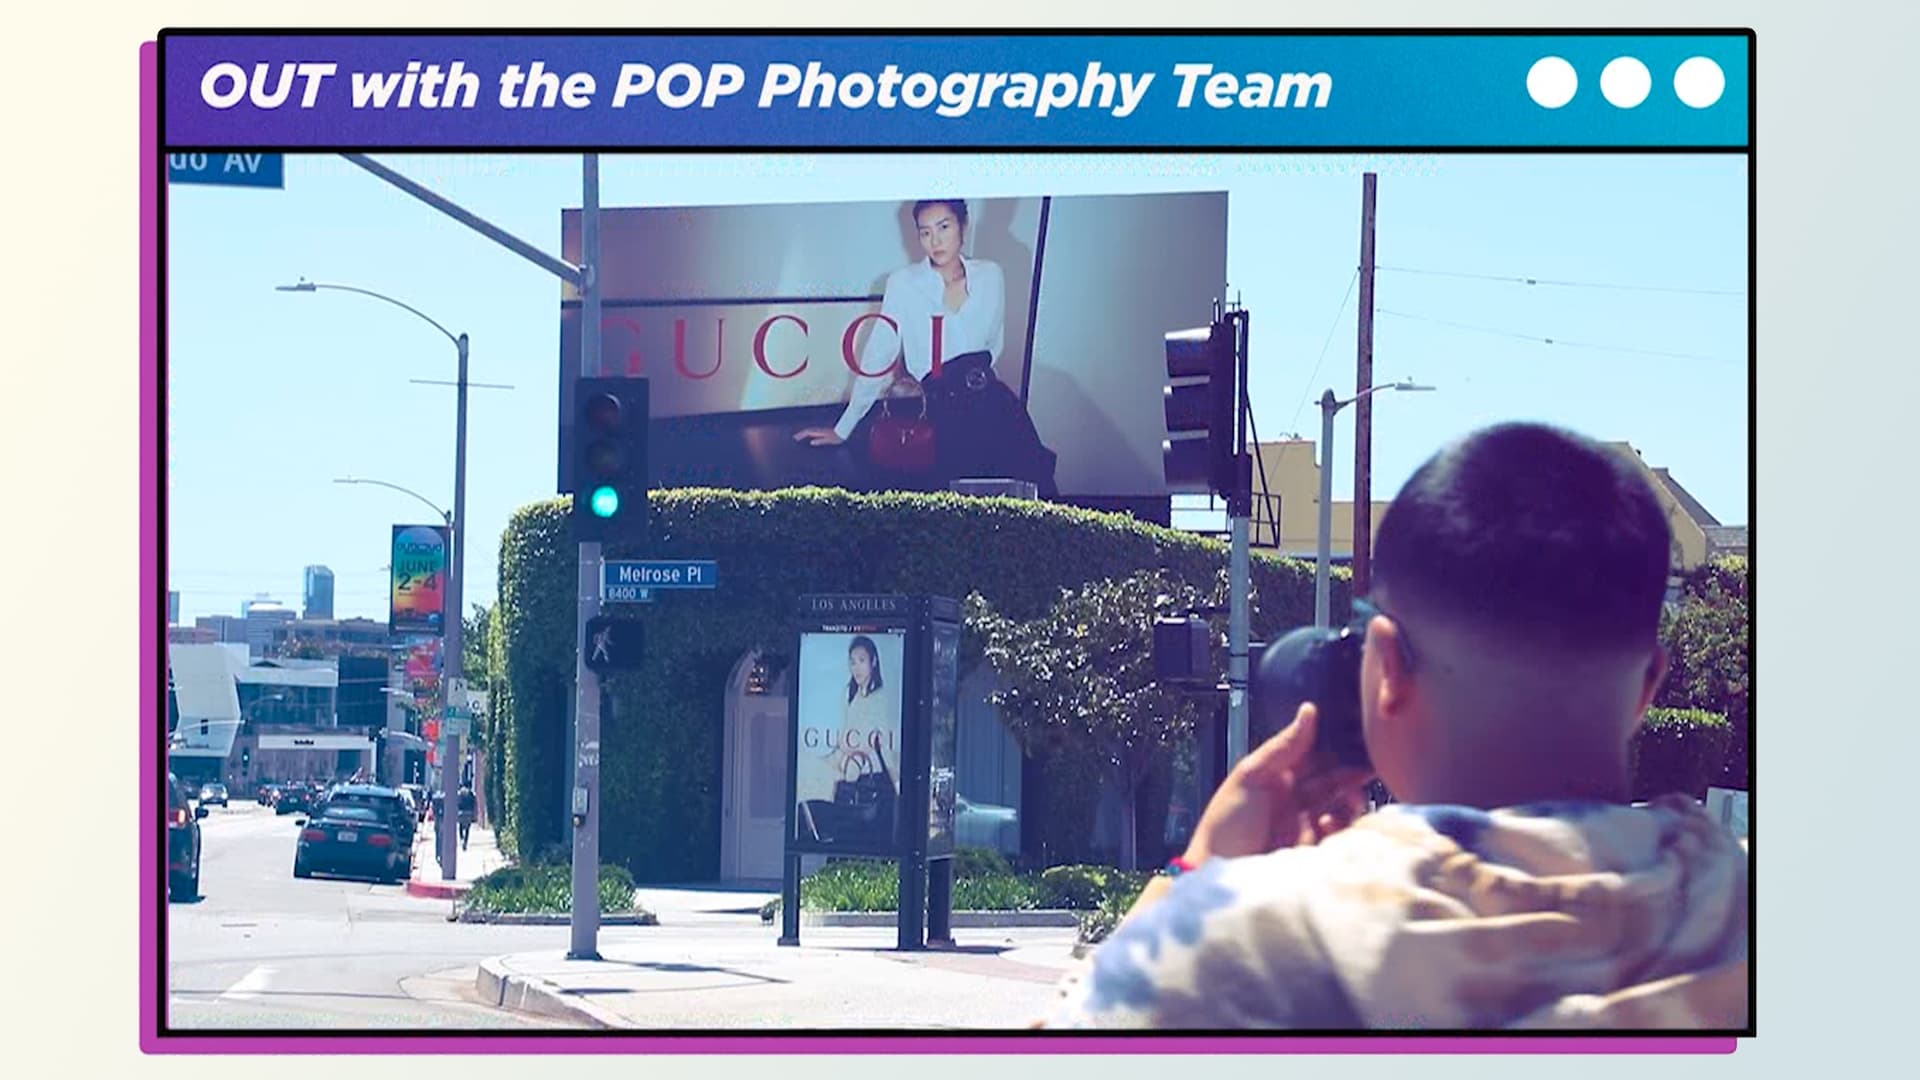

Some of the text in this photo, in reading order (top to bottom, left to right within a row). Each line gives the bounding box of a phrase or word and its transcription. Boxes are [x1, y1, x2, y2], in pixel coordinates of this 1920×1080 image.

[398, 560, 438, 573] JUNE
[620, 566, 702, 583] Melrose Pl
[608, 588, 649, 599] 8400 W
[811, 599, 897, 612] LOS ANGELES
[803, 728, 894, 751] GUCCI
